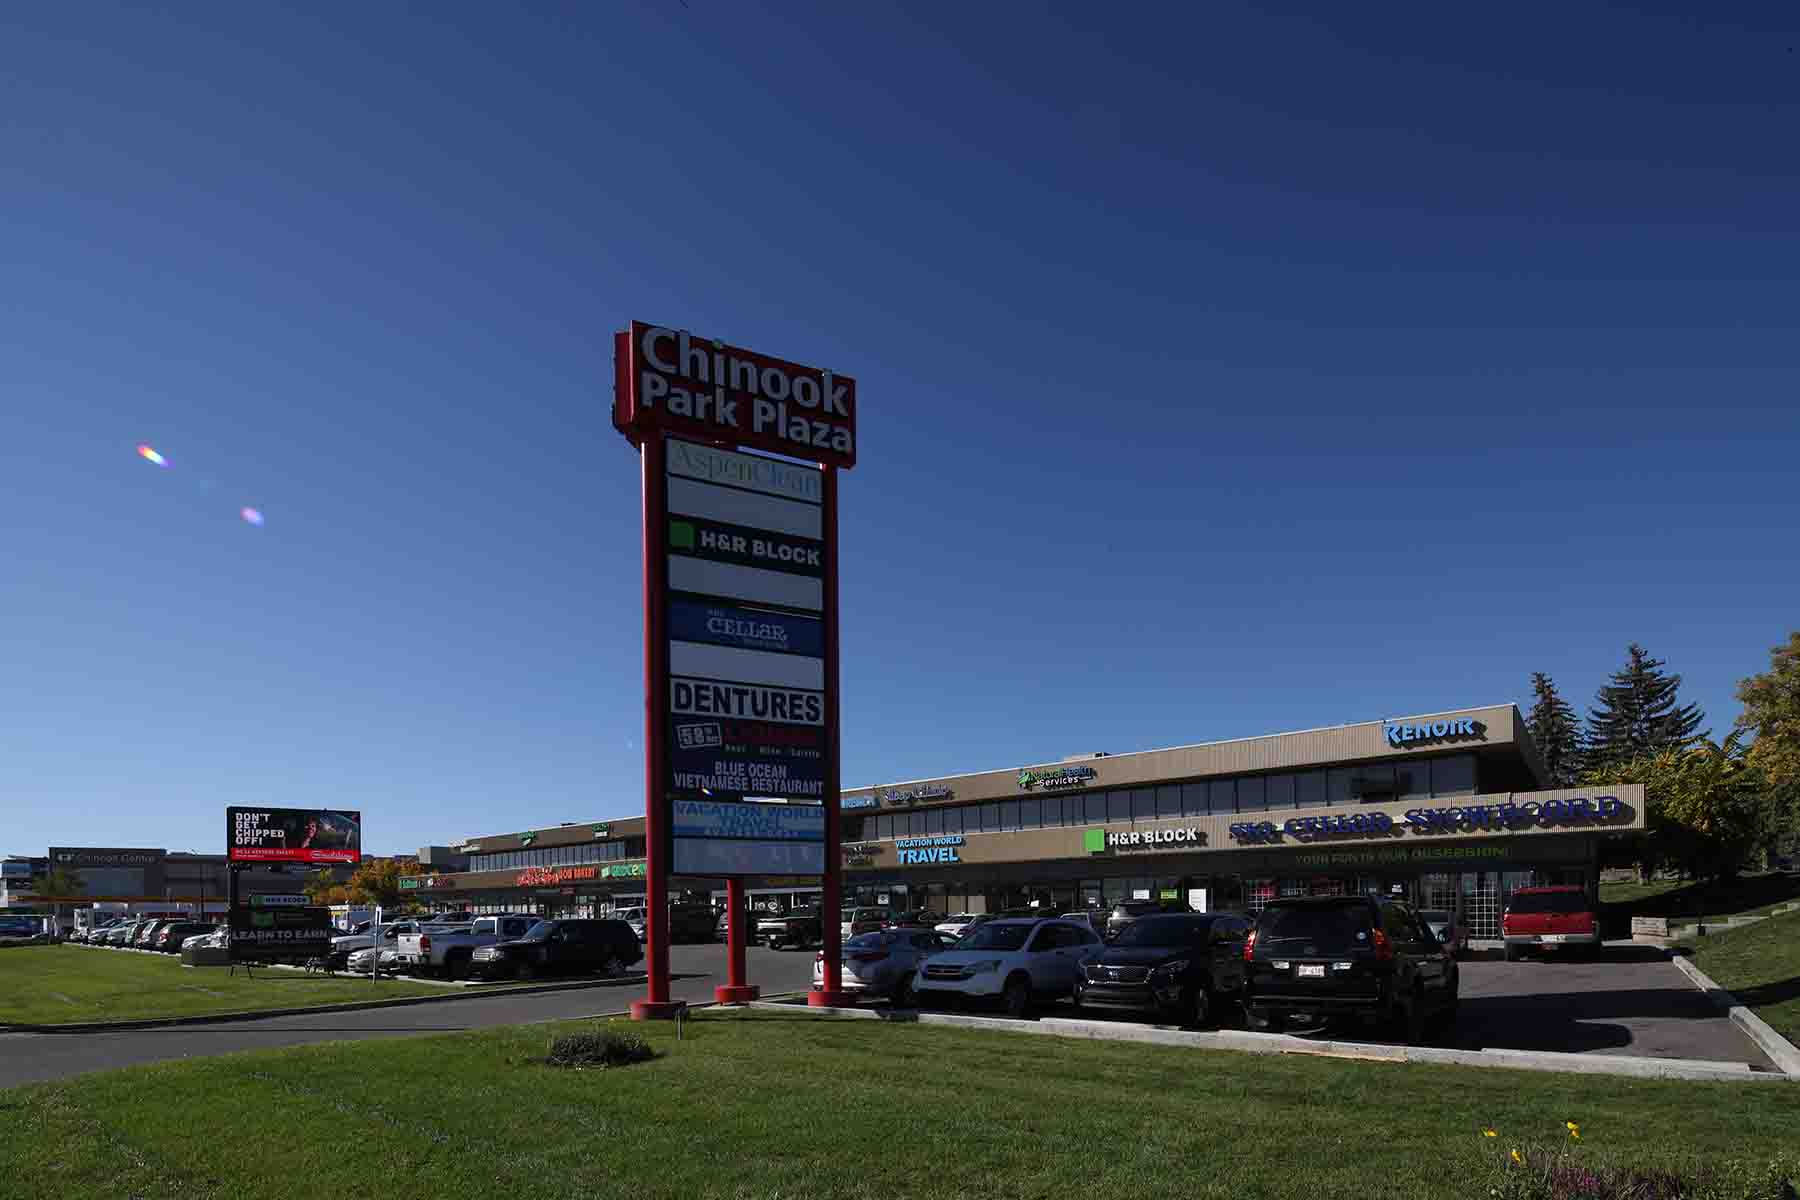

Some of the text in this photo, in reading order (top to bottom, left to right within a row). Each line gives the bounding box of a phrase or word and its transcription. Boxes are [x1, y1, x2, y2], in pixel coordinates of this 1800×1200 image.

[640, 327, 849, 418] Chinook
[641, 371, 853, 454] Park Plaza
[699, 529, 821, 567] H&R BLOCK
[674, 682, 821, 723] DENTURES
[1383, 717, 1475, 745] RENOIR
[714, 760, 787, 782] BLUE OCEAN
[673, 770, 825, 798] VIETNAMESE RESTAURANT
[235, 812, 271, 823] DON'T
[235, 820, 259, 830] GET
[235, 828, 285, 840] CHIPPED
[895, 836, 962, 849] VACATION WORLD
[1108, 827, 1198, 846] H&R BLOCK
[897, 847, 960, 864] TRAVEL
